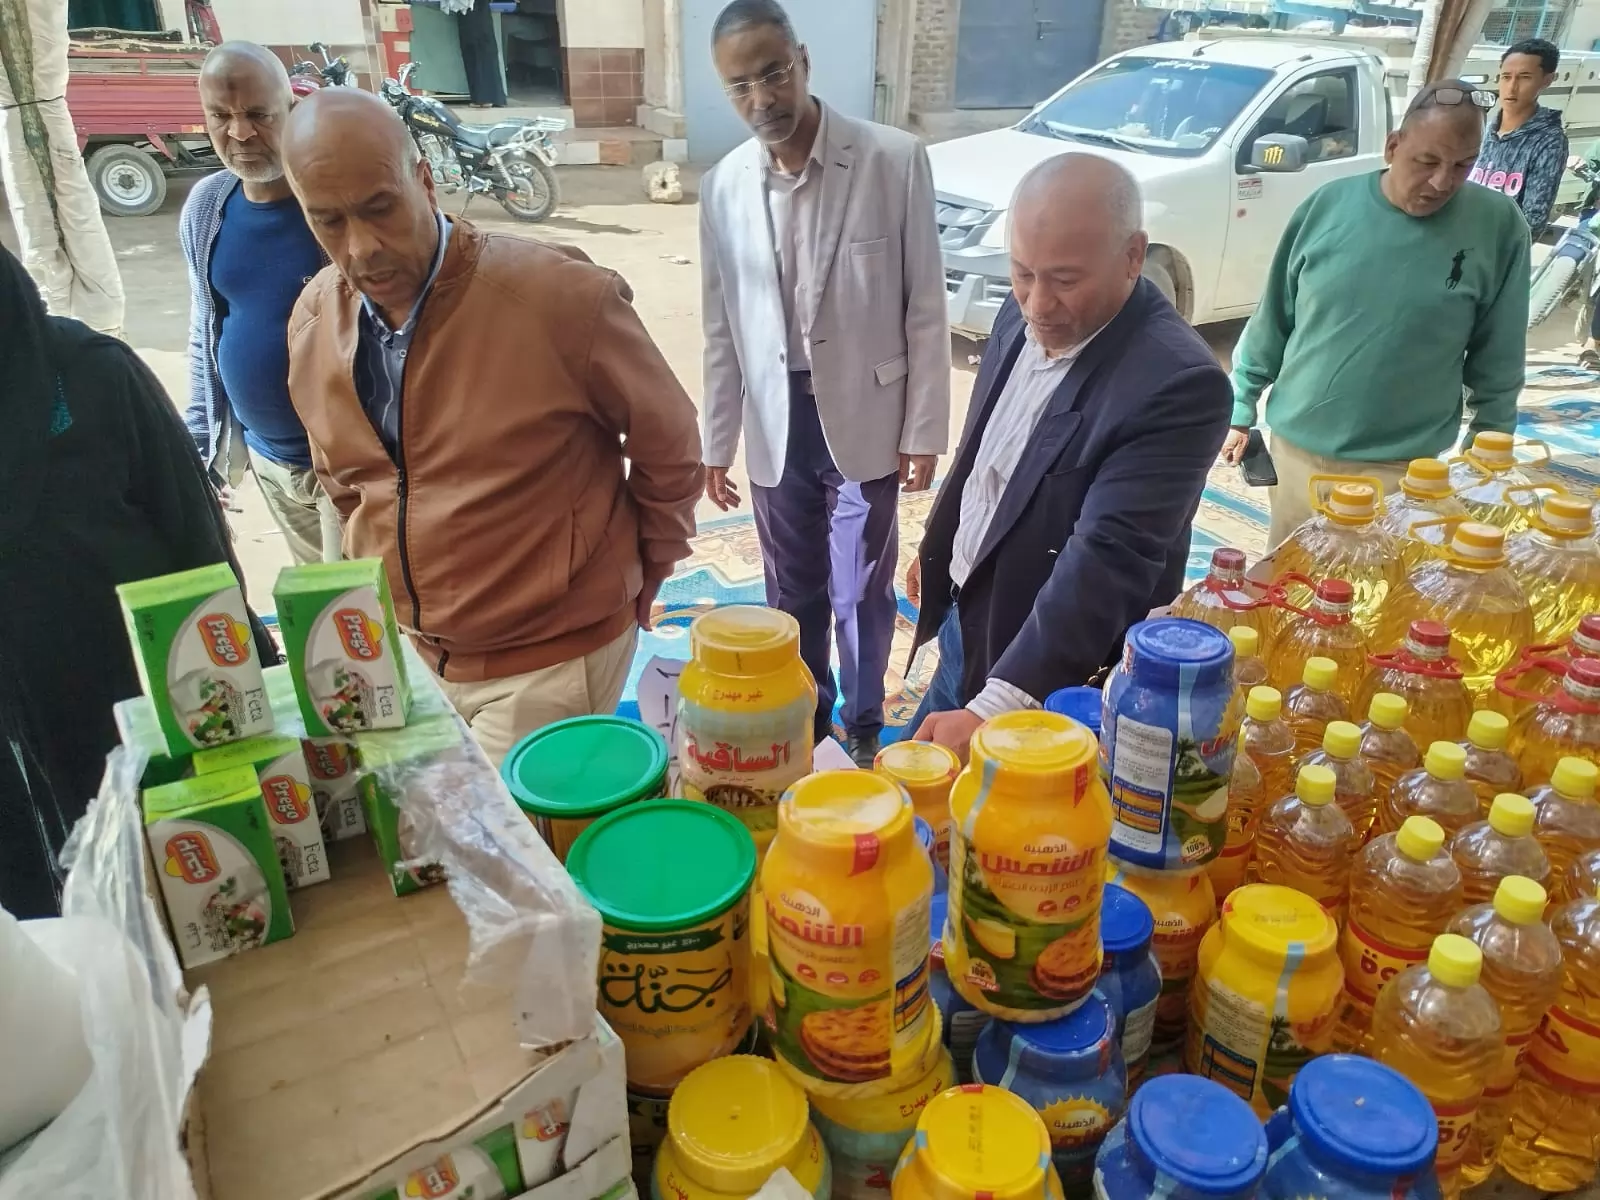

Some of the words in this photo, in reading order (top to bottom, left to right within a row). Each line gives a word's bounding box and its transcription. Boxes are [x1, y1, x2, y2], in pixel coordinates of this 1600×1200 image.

[207, 619, 240, 662] Prego
[342, 614, 373, 657] Prego
[245, 687, 263, 723] Feta
[376, 684, 394, 718] Feta
[713, 688, 742, 702] مهدرج
[685, 730, 791, 775] الساقية
[270, 779, 300, 820] Prego
[342, 796, 357, 828] Feta
[303, 841, 320, 876] Feta
[980, 847, 1096, 876] الشمس
[1023, 844, 1068, 854] الذهبية
[780, 892, 821, 918] الذهبية
[1053, 1115, 1096, 1129] الذهبية
